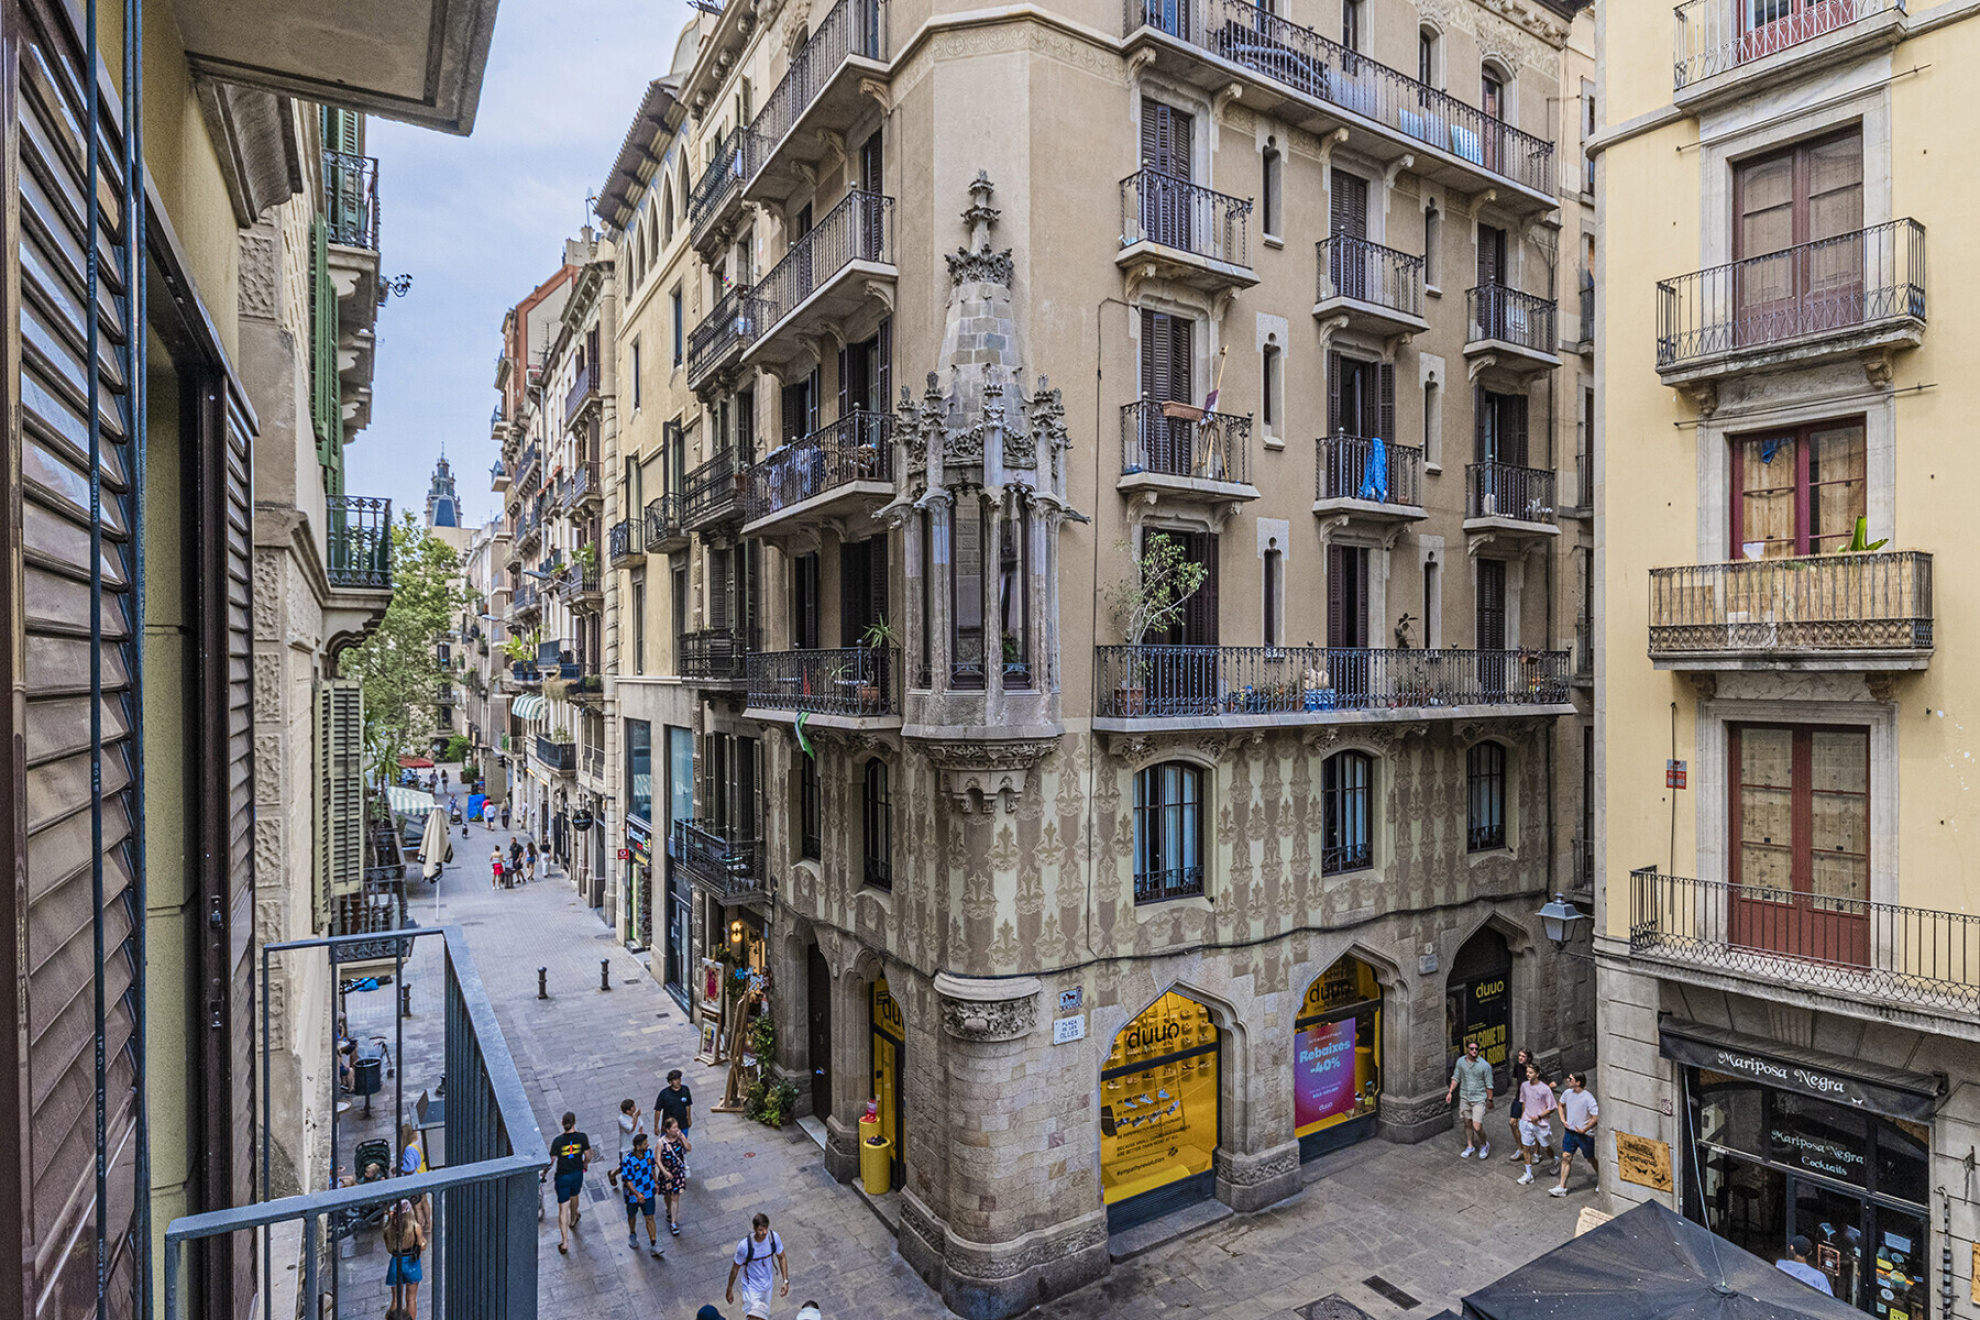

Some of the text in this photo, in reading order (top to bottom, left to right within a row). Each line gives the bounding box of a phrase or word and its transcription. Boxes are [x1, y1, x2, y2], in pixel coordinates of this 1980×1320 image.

[91, 470, 99, 523] CORNING
[1475, 980, 1505, 999] duuo
[1128, 1022, 1180, 1049] duuo
[1299, 1040, 1351, 1063] Rebaixes
[1310, 1056, 1341, 1073] -40%
[1717, 1051, 1845, 1092] Mariposa Negra
[1771, 1129, 1864, 1165] Mariposa Negra
[1801, 1155, 1848, 1176] Cocktails
